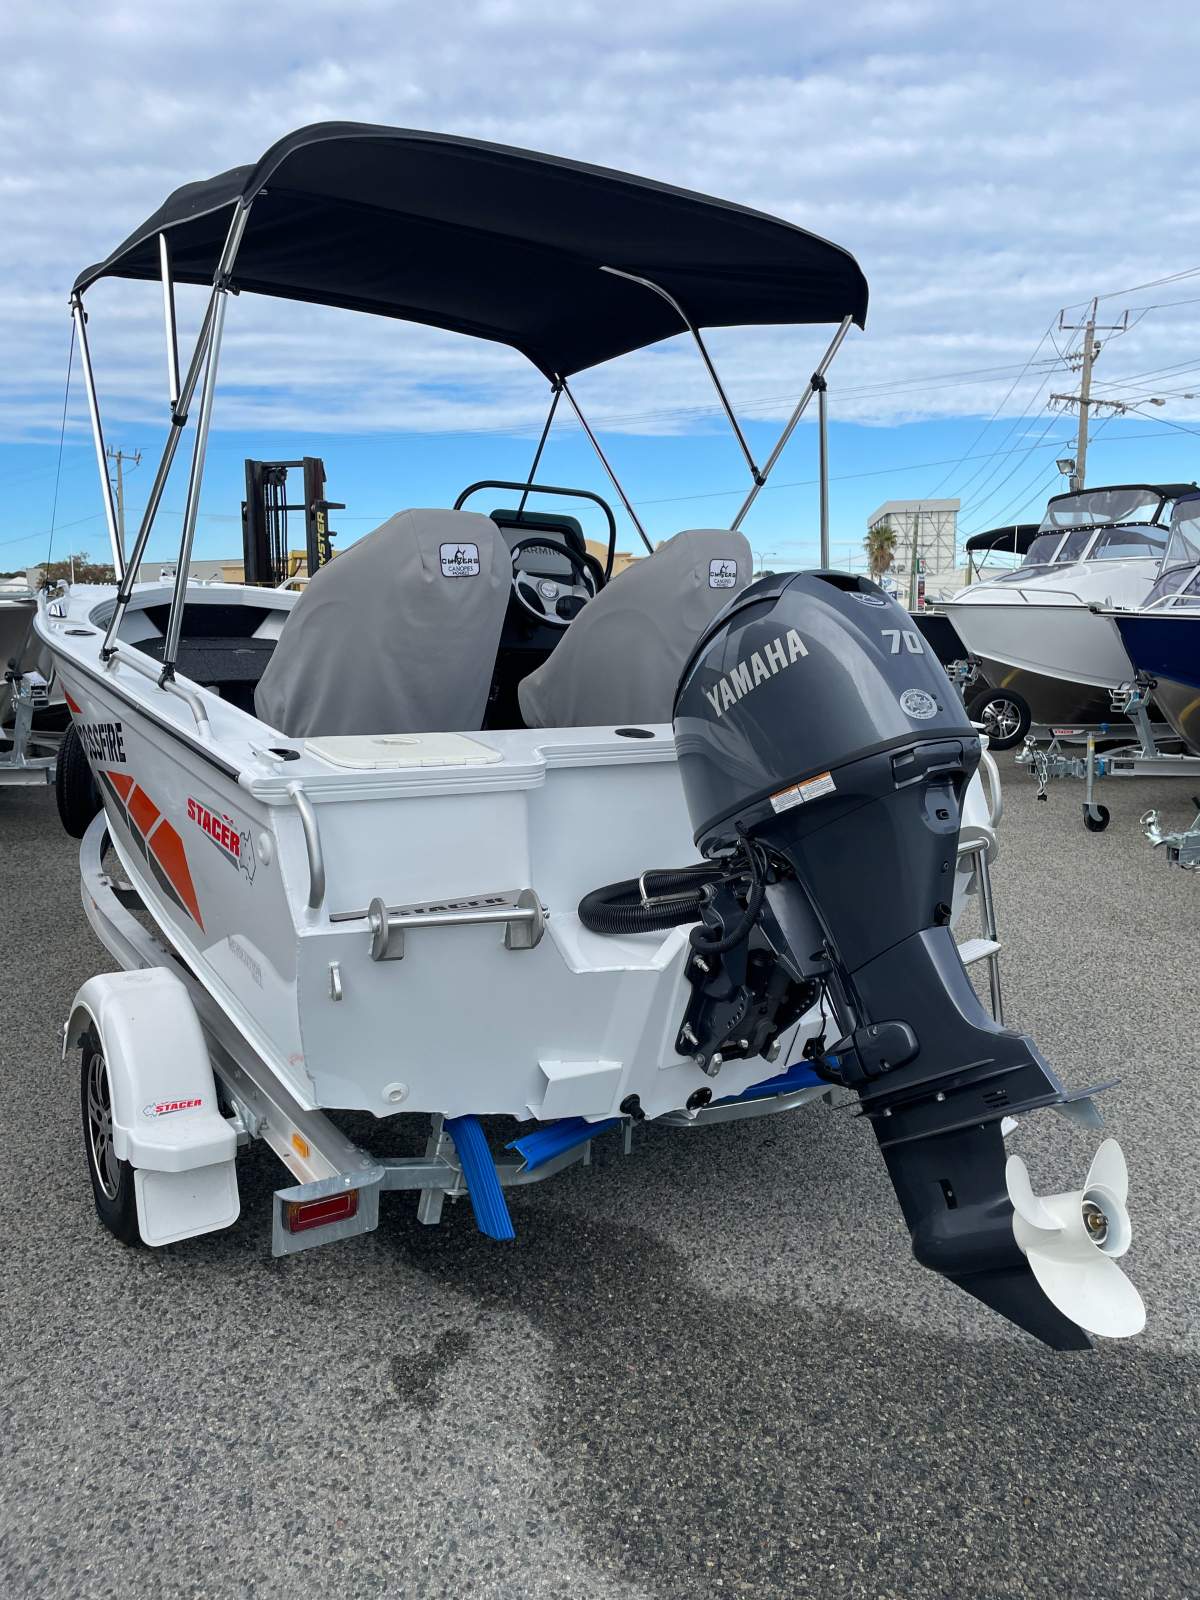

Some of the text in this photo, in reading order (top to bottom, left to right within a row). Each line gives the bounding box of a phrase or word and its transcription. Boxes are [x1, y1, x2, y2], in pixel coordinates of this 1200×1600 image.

[316, 511, 326, 568] YSTER
[523, 546, 561, 556] ARMIN
[880, 630, 924, 654] 70
[706, 629, 809, 717] YAMAHA
[77, 723, 126, 762] OSSFIRE
[187, 798, 240, 857] STACER
[155, 1099, 202, 1112] STACER
